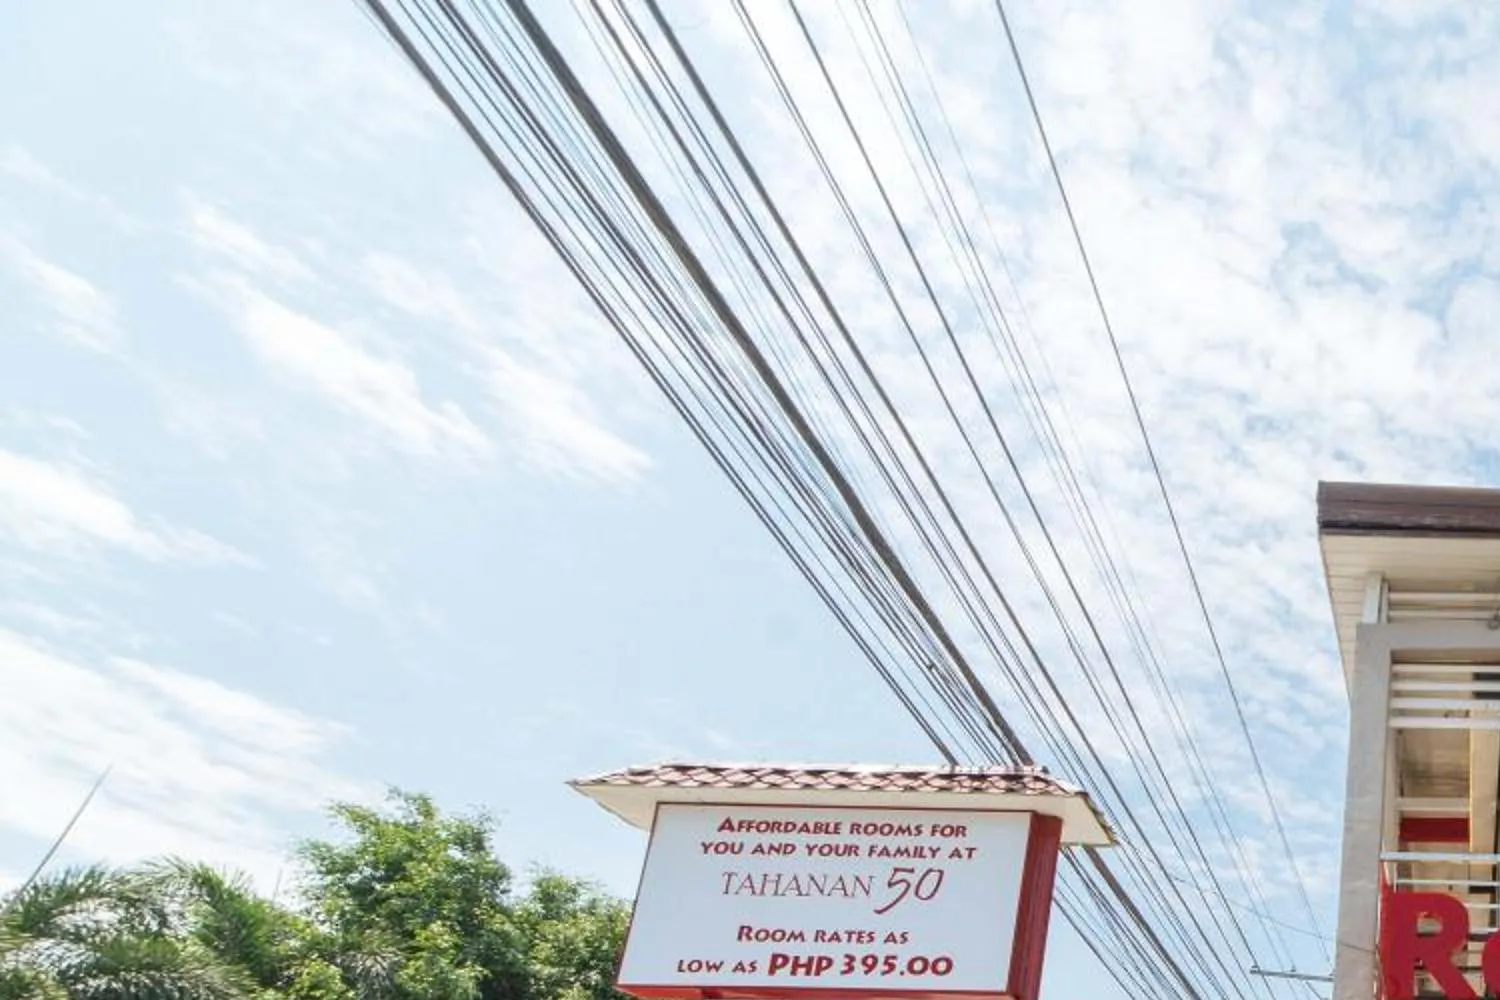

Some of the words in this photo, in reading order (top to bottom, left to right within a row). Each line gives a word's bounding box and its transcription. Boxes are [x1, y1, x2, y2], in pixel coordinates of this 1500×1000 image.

[717, 817, 841, 836] AFFORDABLE
[849, 822, 923, 838] ROOMS
[930, 824, 967, 839] FOR
[700, 841, 744, 856] YOU
[751, 843, 796, 857] AND
[805, 843, 860, 858] YOUR
[867, 844, 941, 860] FAMILY
[949, 846, 978, 860] AT
[721, 871, 876, 899] TAHANAN
[873, 866, 945, 915] 50
[736, 925, 806, 944] ROOM
[813, 929, 876, 945] RATES
[883, 930, 910, 945] AS
[677, 959, 724, 974] LOW
[731, 959, 758, 974] AS
[768, 953, 833, 978] PHP
[839, 953, 954, 977] 395.00
